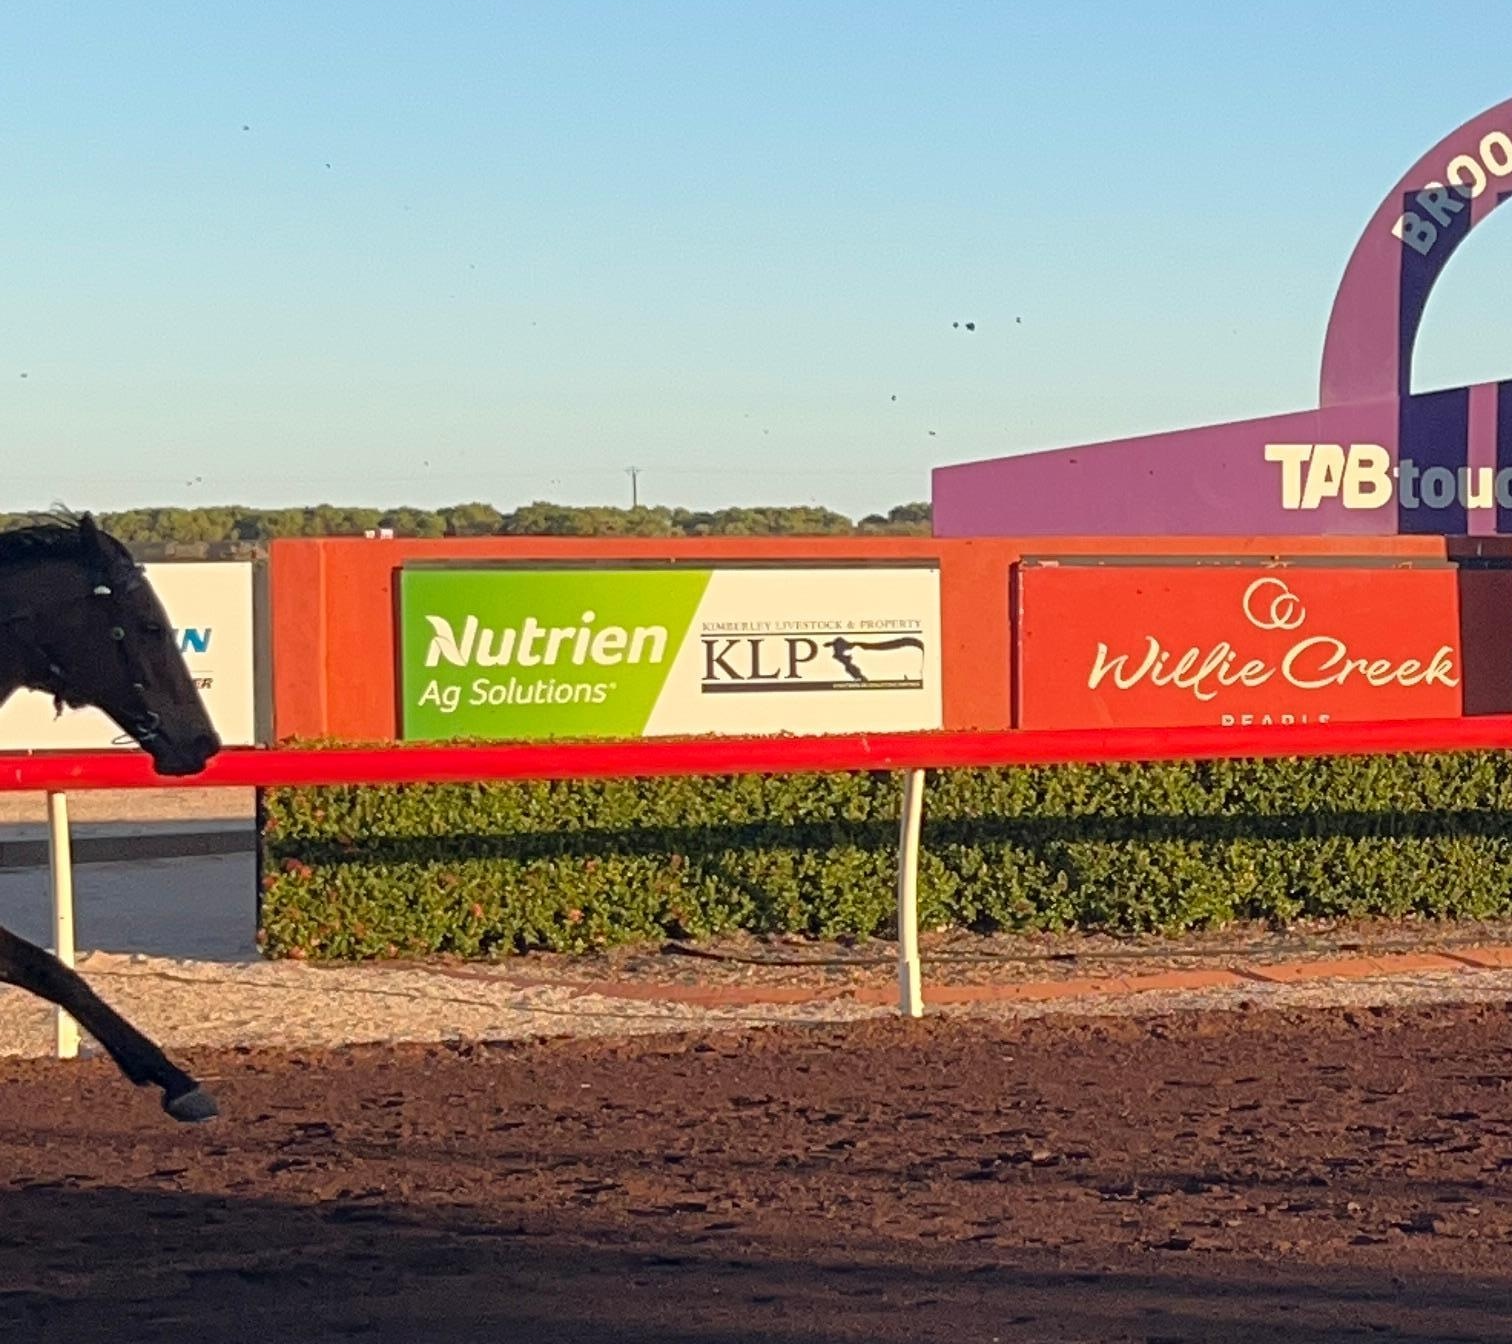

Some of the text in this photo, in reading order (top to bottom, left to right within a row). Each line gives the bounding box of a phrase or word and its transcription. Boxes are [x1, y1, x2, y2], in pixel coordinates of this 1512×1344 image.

[424, 610, 669, 667] Nutrien
[702, 622, 772, 633] KIMBERLEY
[775, 619, 843, 631] LIVESTOCK
[860, 619, 922, 630] PROPERTY
[701, 637, 819, 681] KLP
[1087, 635, 1459, 702] Willie Creek
[418, 676, 609, 713] Ag Solutions
